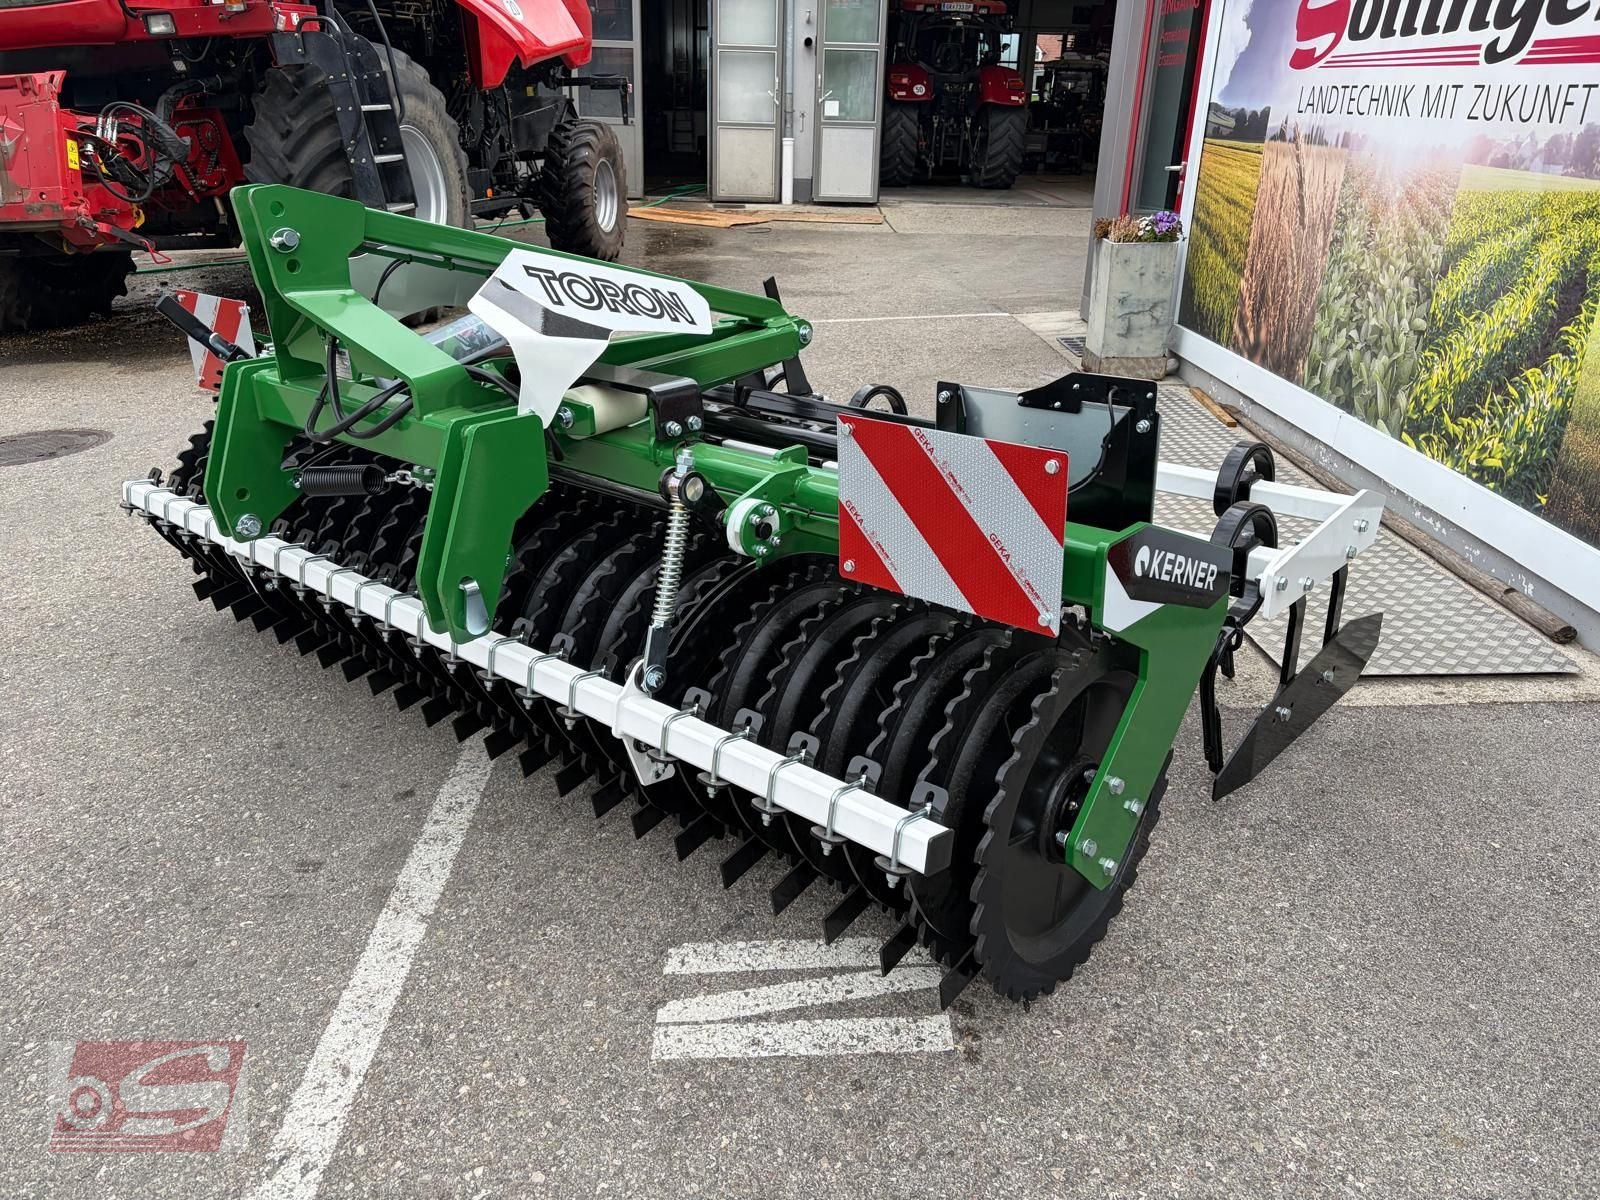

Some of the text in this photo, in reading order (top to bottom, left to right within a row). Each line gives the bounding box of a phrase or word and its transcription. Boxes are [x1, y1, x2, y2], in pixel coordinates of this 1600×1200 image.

[1297, 83, 1599, 125] LANDTECHNIK MIT ZUKUNFT
[522, 264, 698, 326] TORON
[914, 427, 935, 456] GEKA
[845, 500, 864, 526] GEKA
[989, 533, 1011, 563] GEKA
[1148, 549, 1218, 591] KERNER
